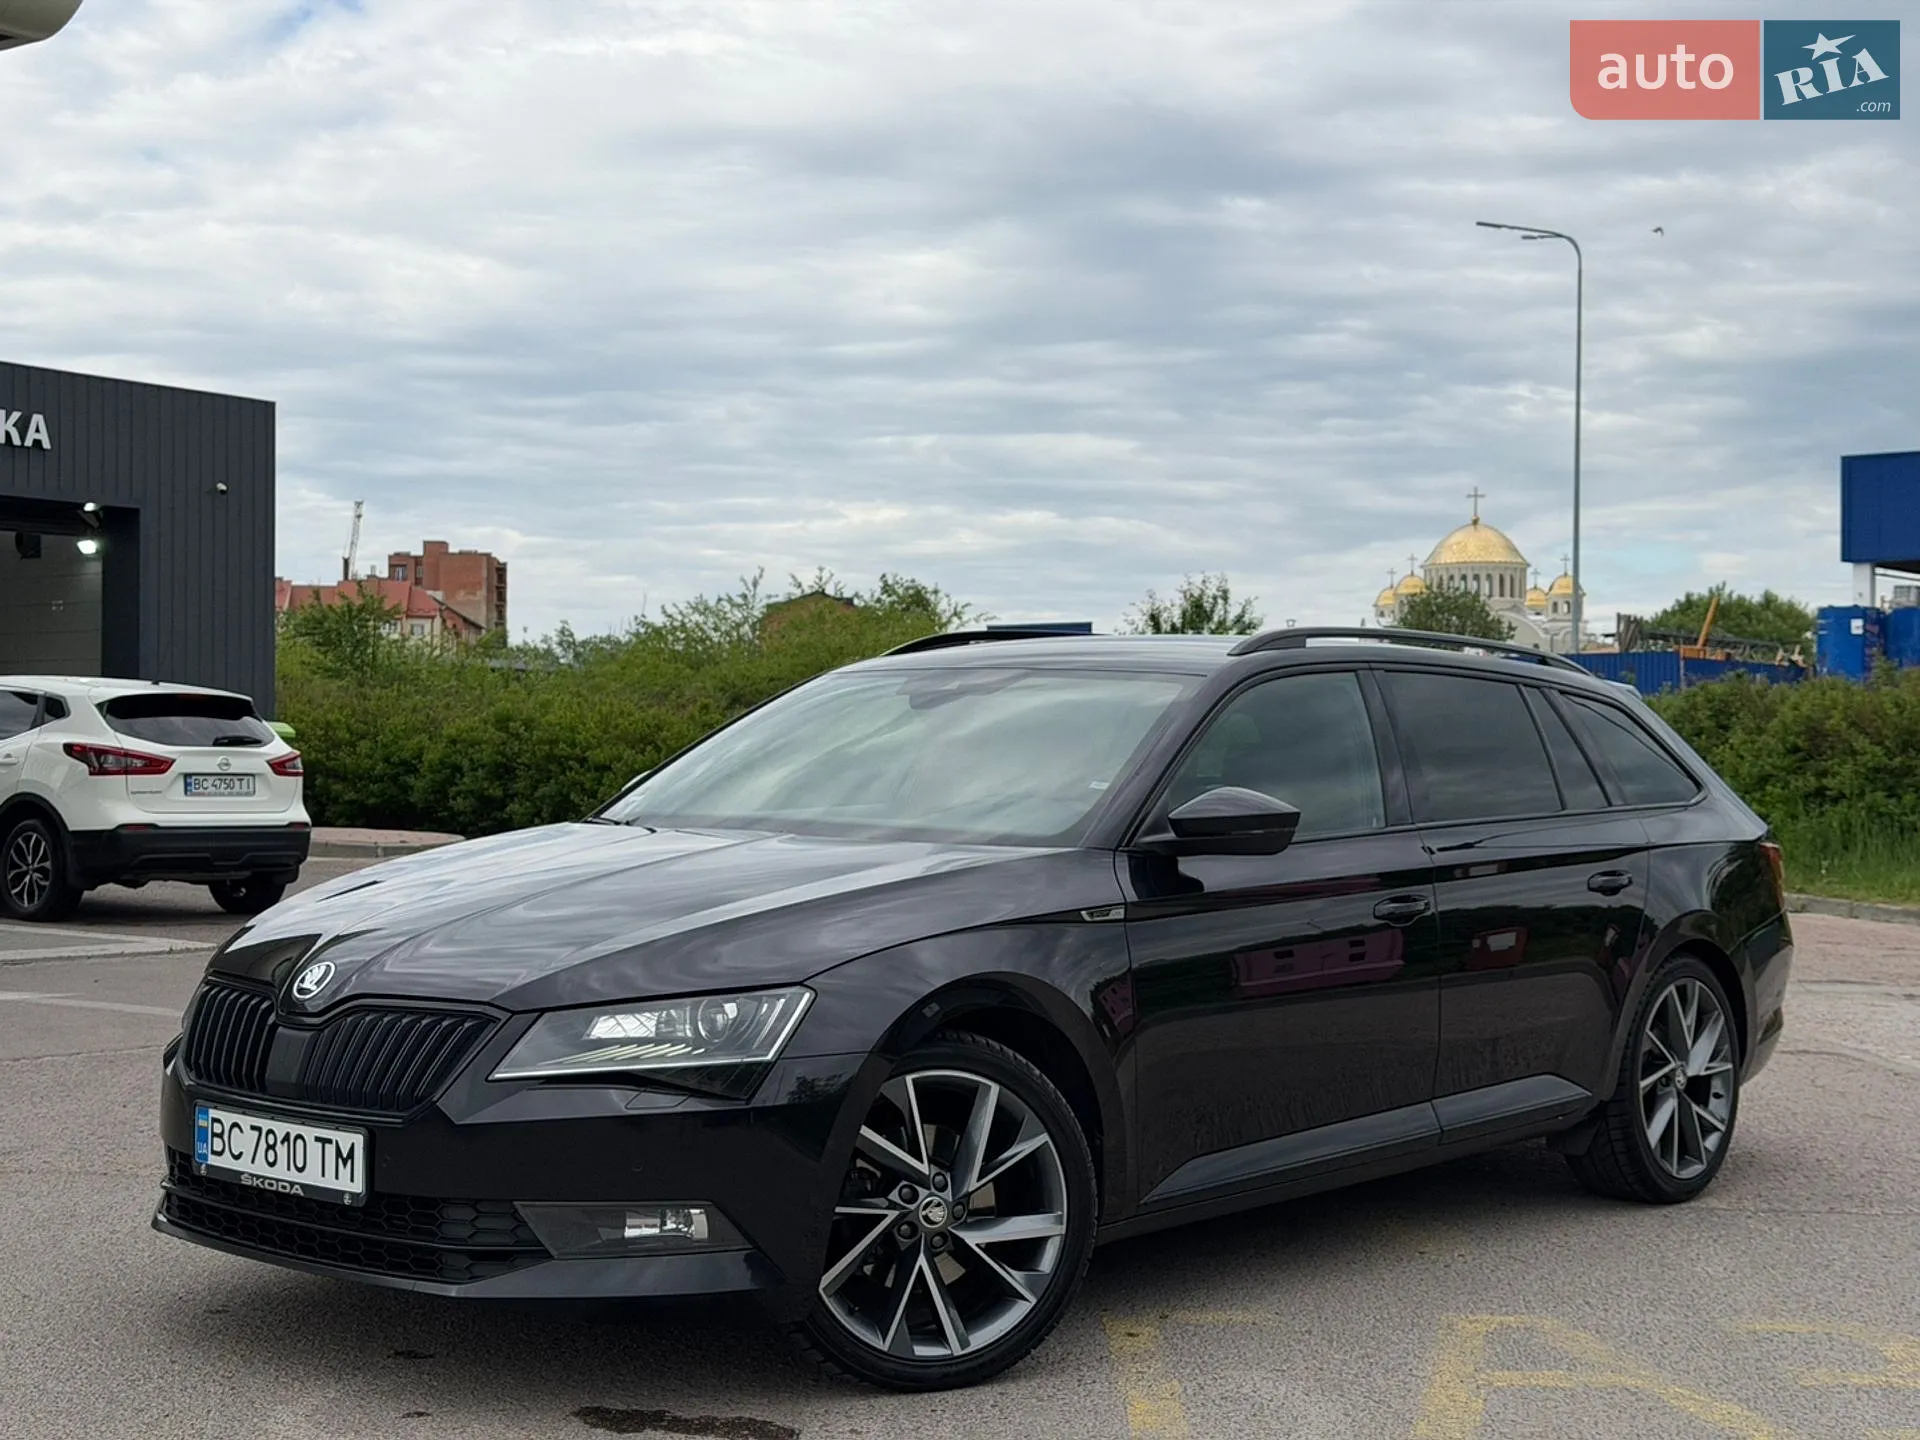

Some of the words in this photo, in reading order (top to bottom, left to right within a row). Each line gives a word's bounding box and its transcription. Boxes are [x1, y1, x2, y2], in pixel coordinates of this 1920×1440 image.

[210, 1117, 244, 1161] BC
[249, 1124, 307, 1173] 7810
[314, 1135, 355, 1183] TM
